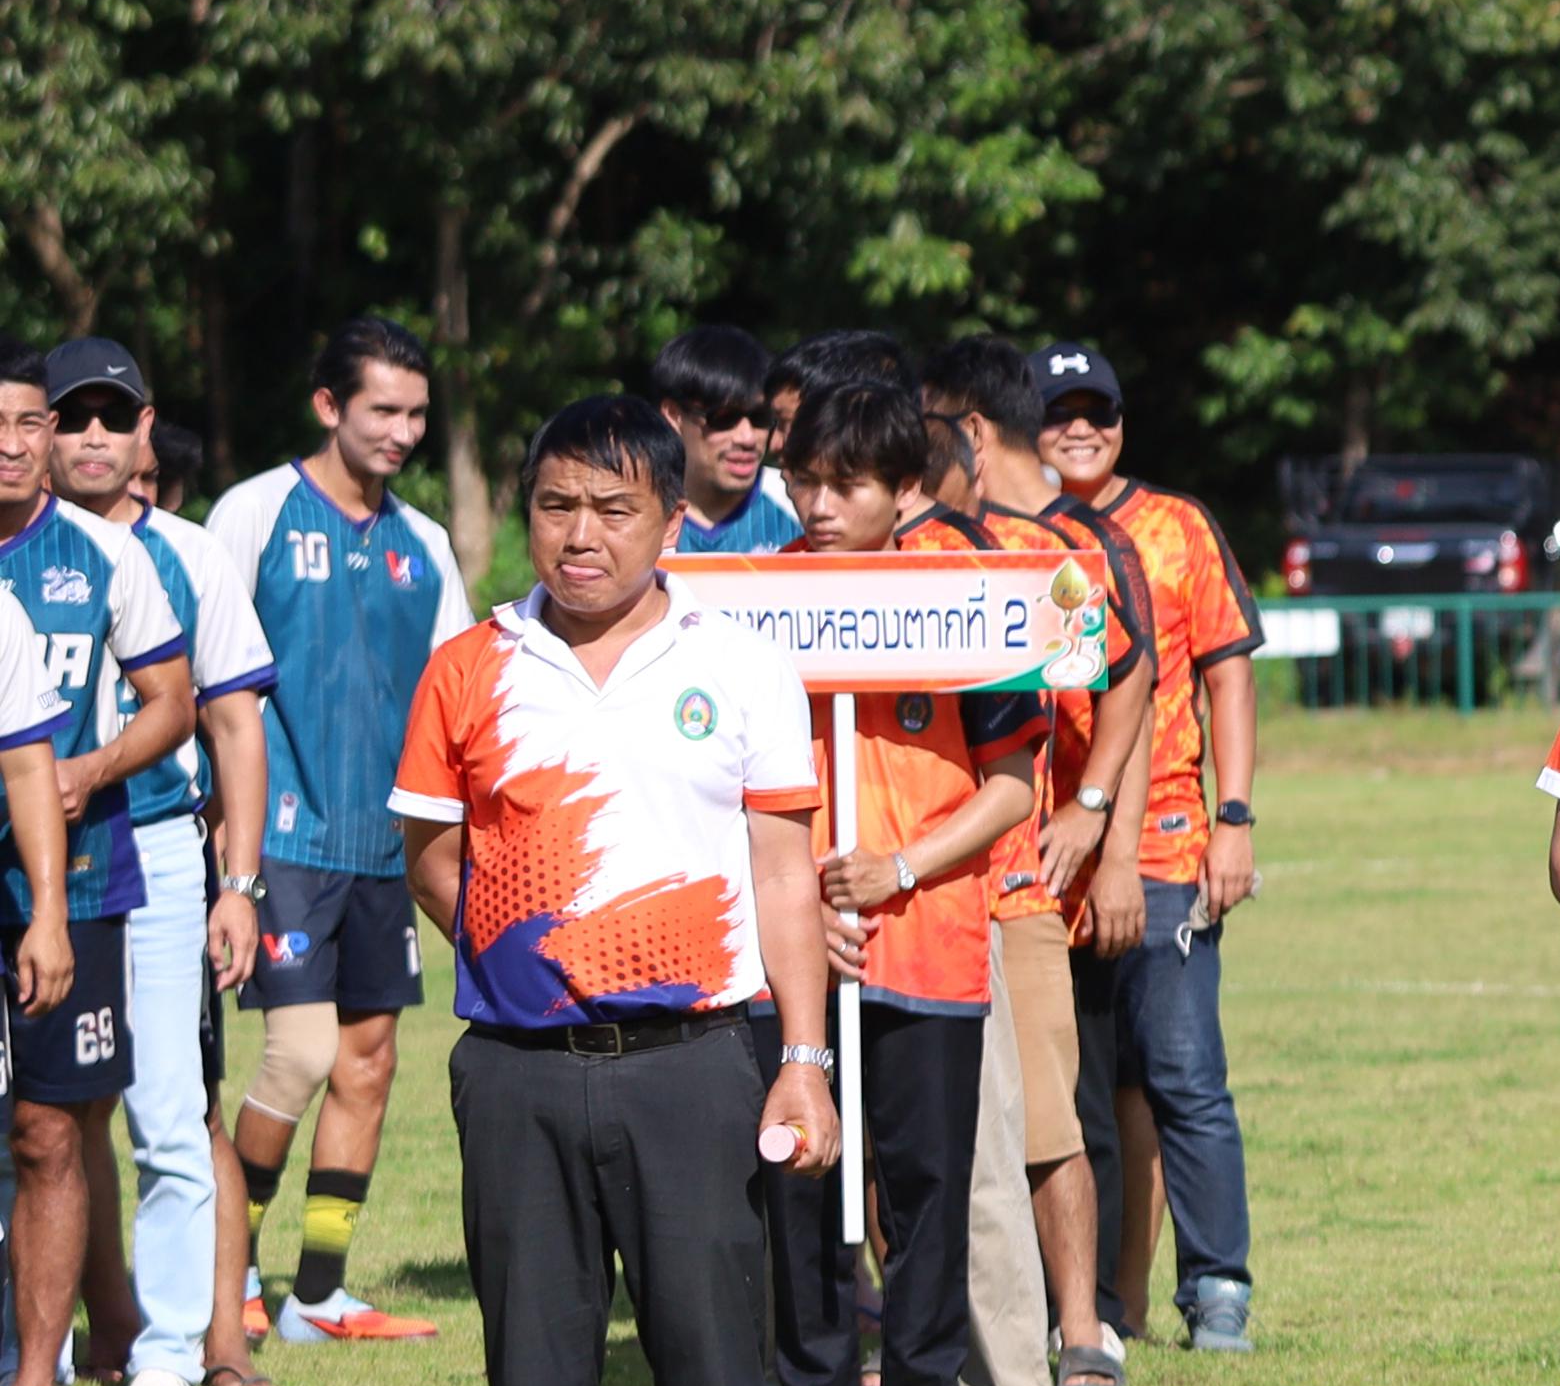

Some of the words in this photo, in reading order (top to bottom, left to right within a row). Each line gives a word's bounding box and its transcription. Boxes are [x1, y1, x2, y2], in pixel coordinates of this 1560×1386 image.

[287, 529, 332, 583] 10
[1004, 599, 1028, 648] 2
[75, 1006, 116, 1064] 69
